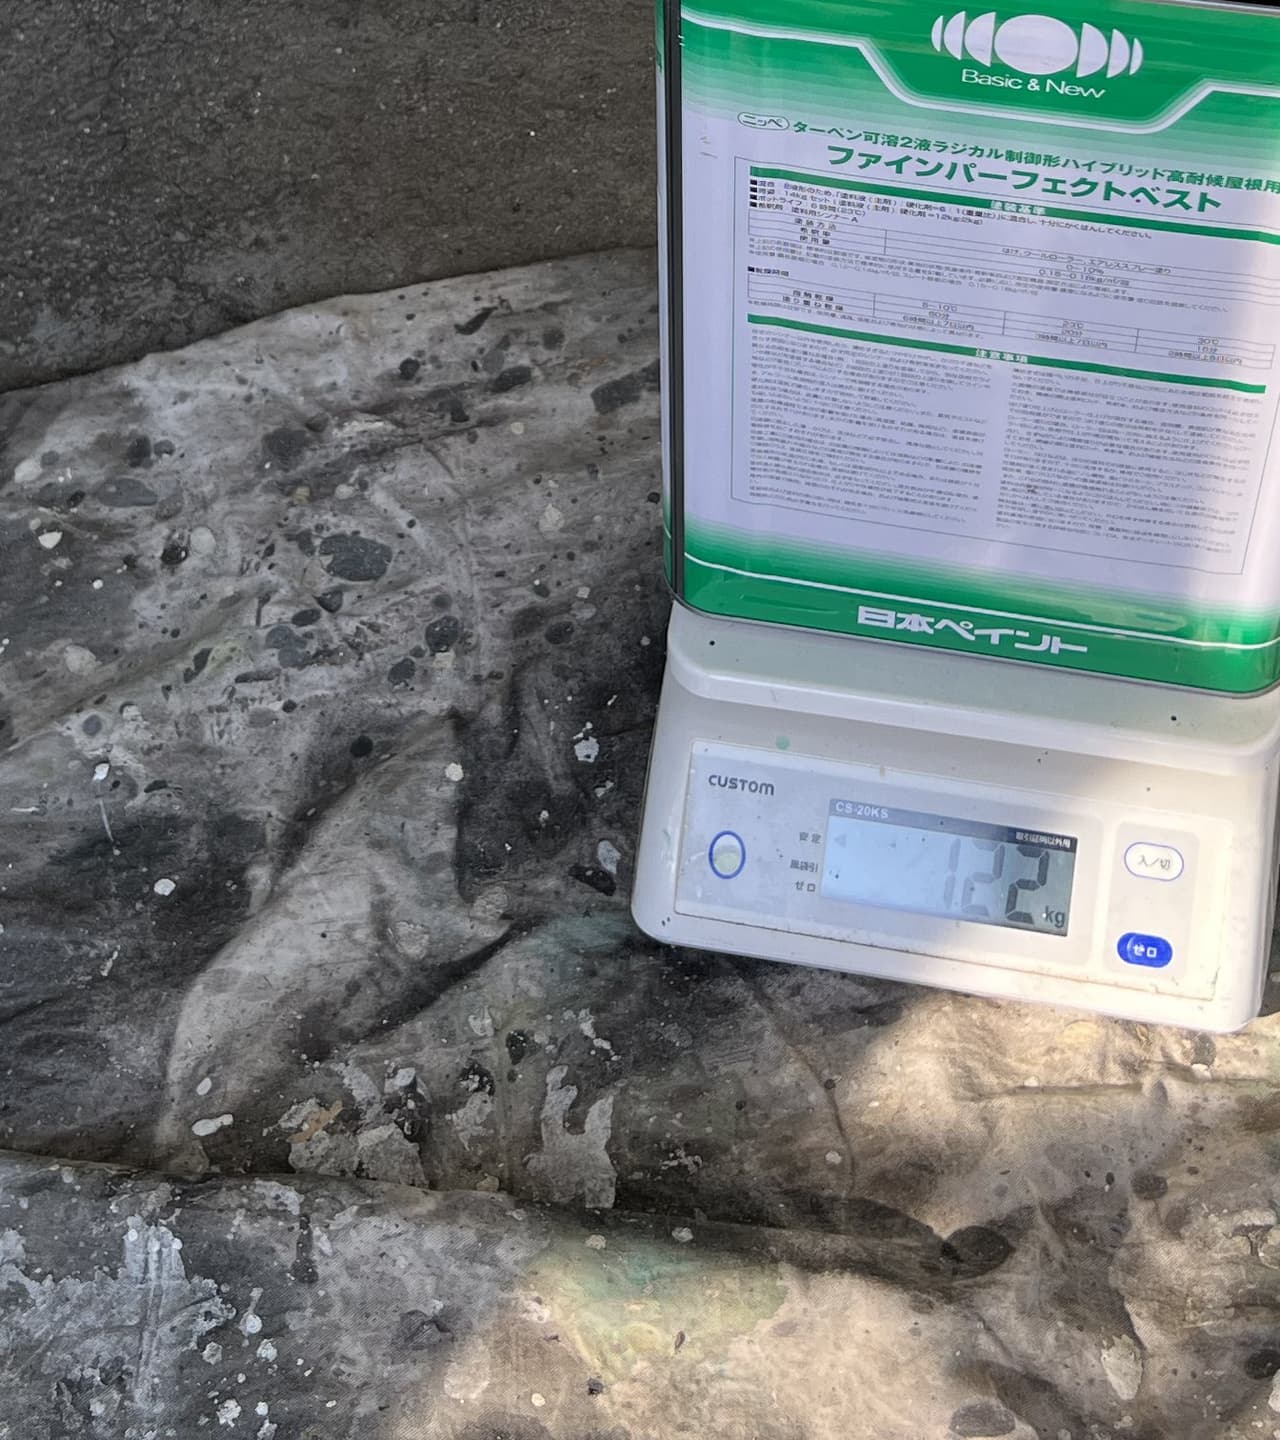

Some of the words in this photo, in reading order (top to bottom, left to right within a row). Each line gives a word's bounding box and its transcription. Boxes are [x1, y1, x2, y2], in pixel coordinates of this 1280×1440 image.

[961, 68, 1023, 90] Basic
[1027, 78, 1040, 92] &
[1045, 79, 1106, 99] New
[741, 113, 784, 128] ニッペ
[827, 145, 1222, 213] ファインパーフェクトベスト
[857, 605, 1088, 655] 日本ペイント
[707, 773, 775, 796] CUSTOM
[835, 800, 889, 819] CS-20KS
